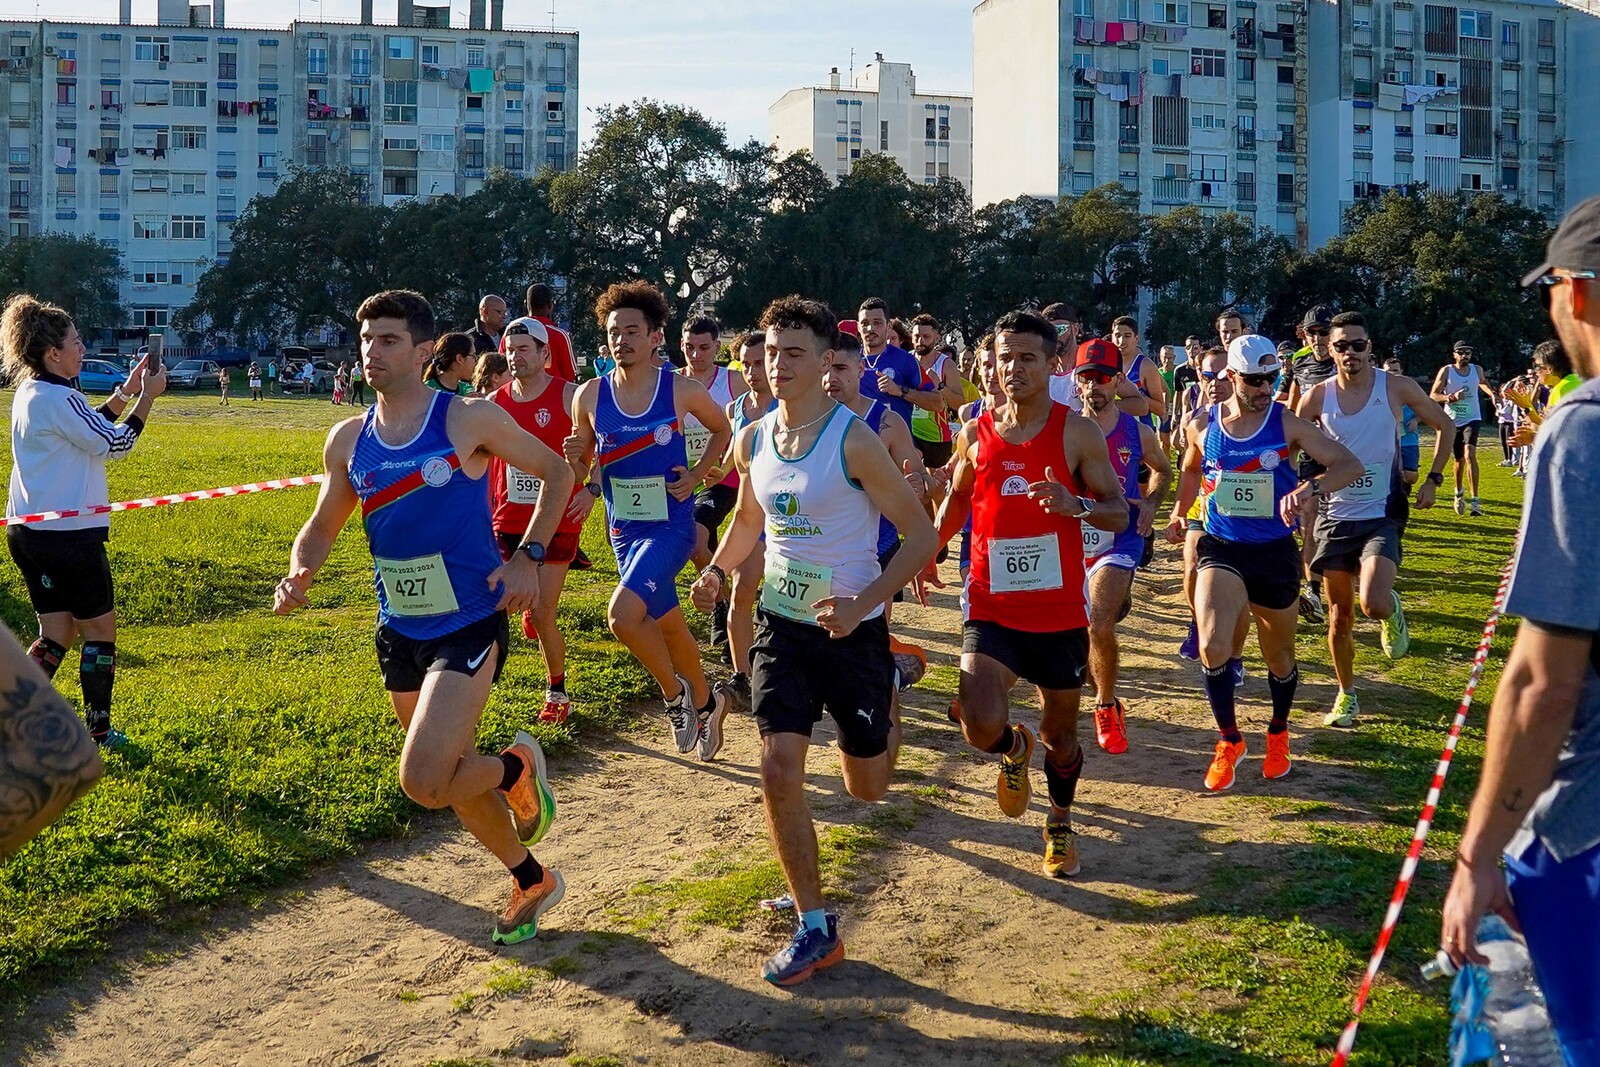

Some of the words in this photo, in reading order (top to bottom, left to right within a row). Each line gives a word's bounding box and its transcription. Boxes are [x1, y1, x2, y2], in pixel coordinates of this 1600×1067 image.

[516, 480, 541, 492] 599
[632, 493, 642, 507] 2
[1234, 488, 1254, 502] 65
[1006, 555, 1041, 574] 667
[787, 567, 823, 580] 2023/2024
[395, 577, 427, 597] 427
[777, 577, 810, 601] 207
